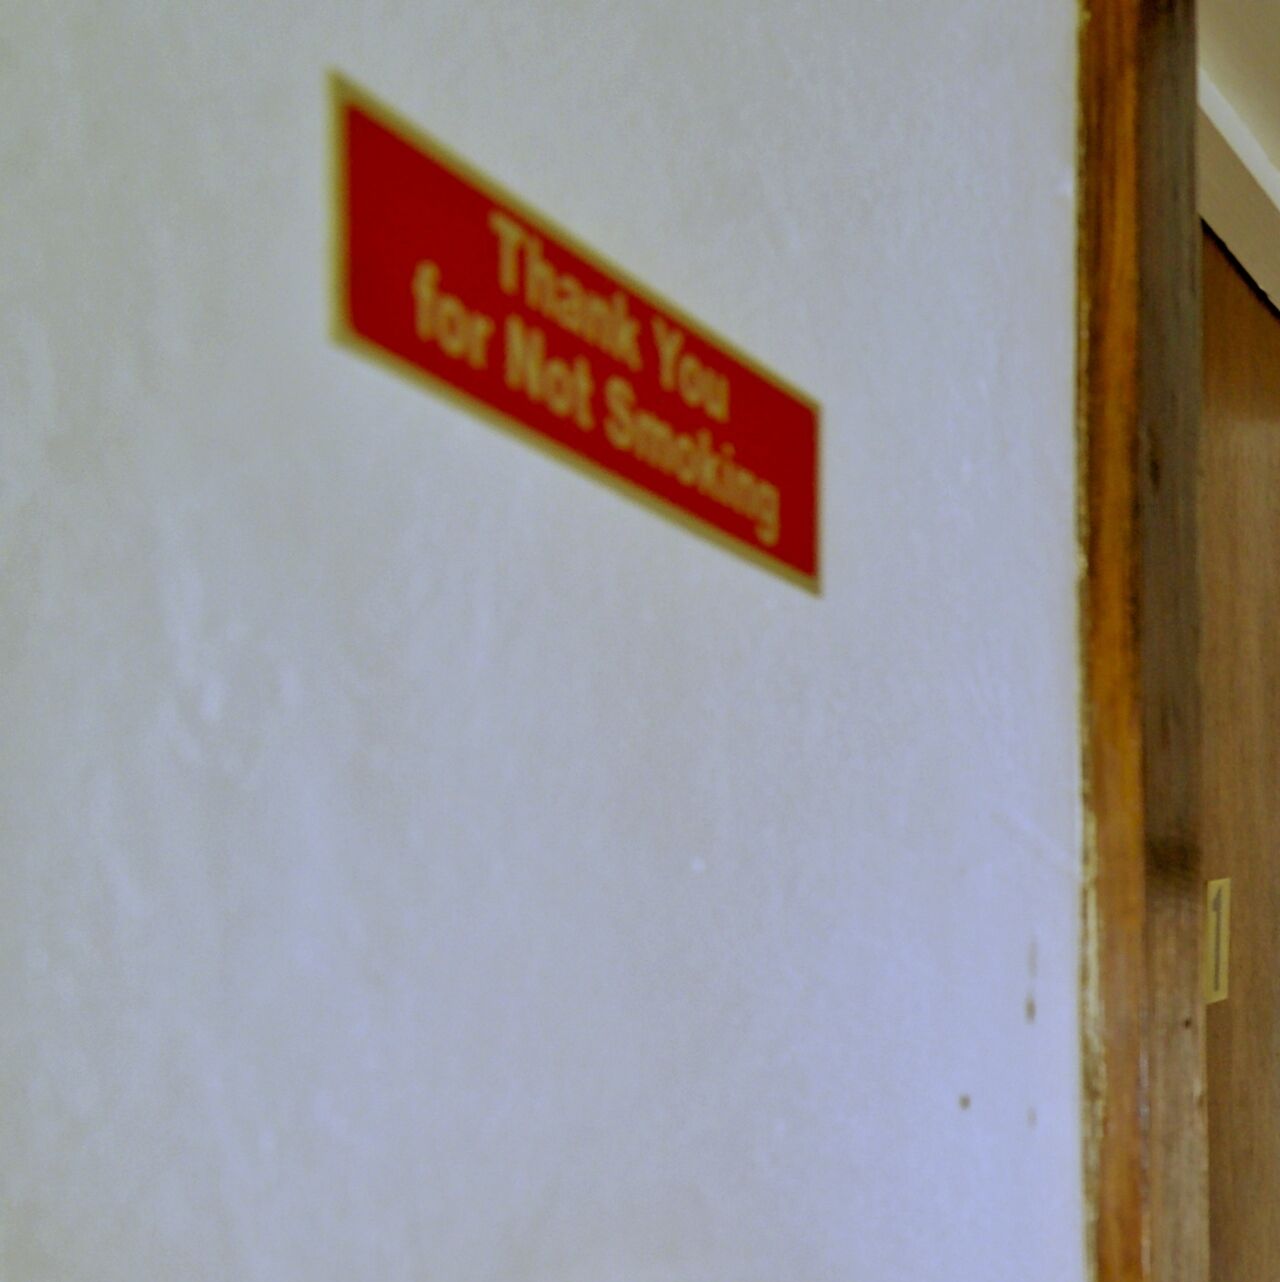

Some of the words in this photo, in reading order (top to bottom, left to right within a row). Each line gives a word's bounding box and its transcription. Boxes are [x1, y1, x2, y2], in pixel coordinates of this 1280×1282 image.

[412, 260, 494, 369] for
[505, 314, 595, 429] Not
[604, 376, 780, 545] Smoking
[490, 211, 642, 371] Thank
[653, 315, 730, 423] You
